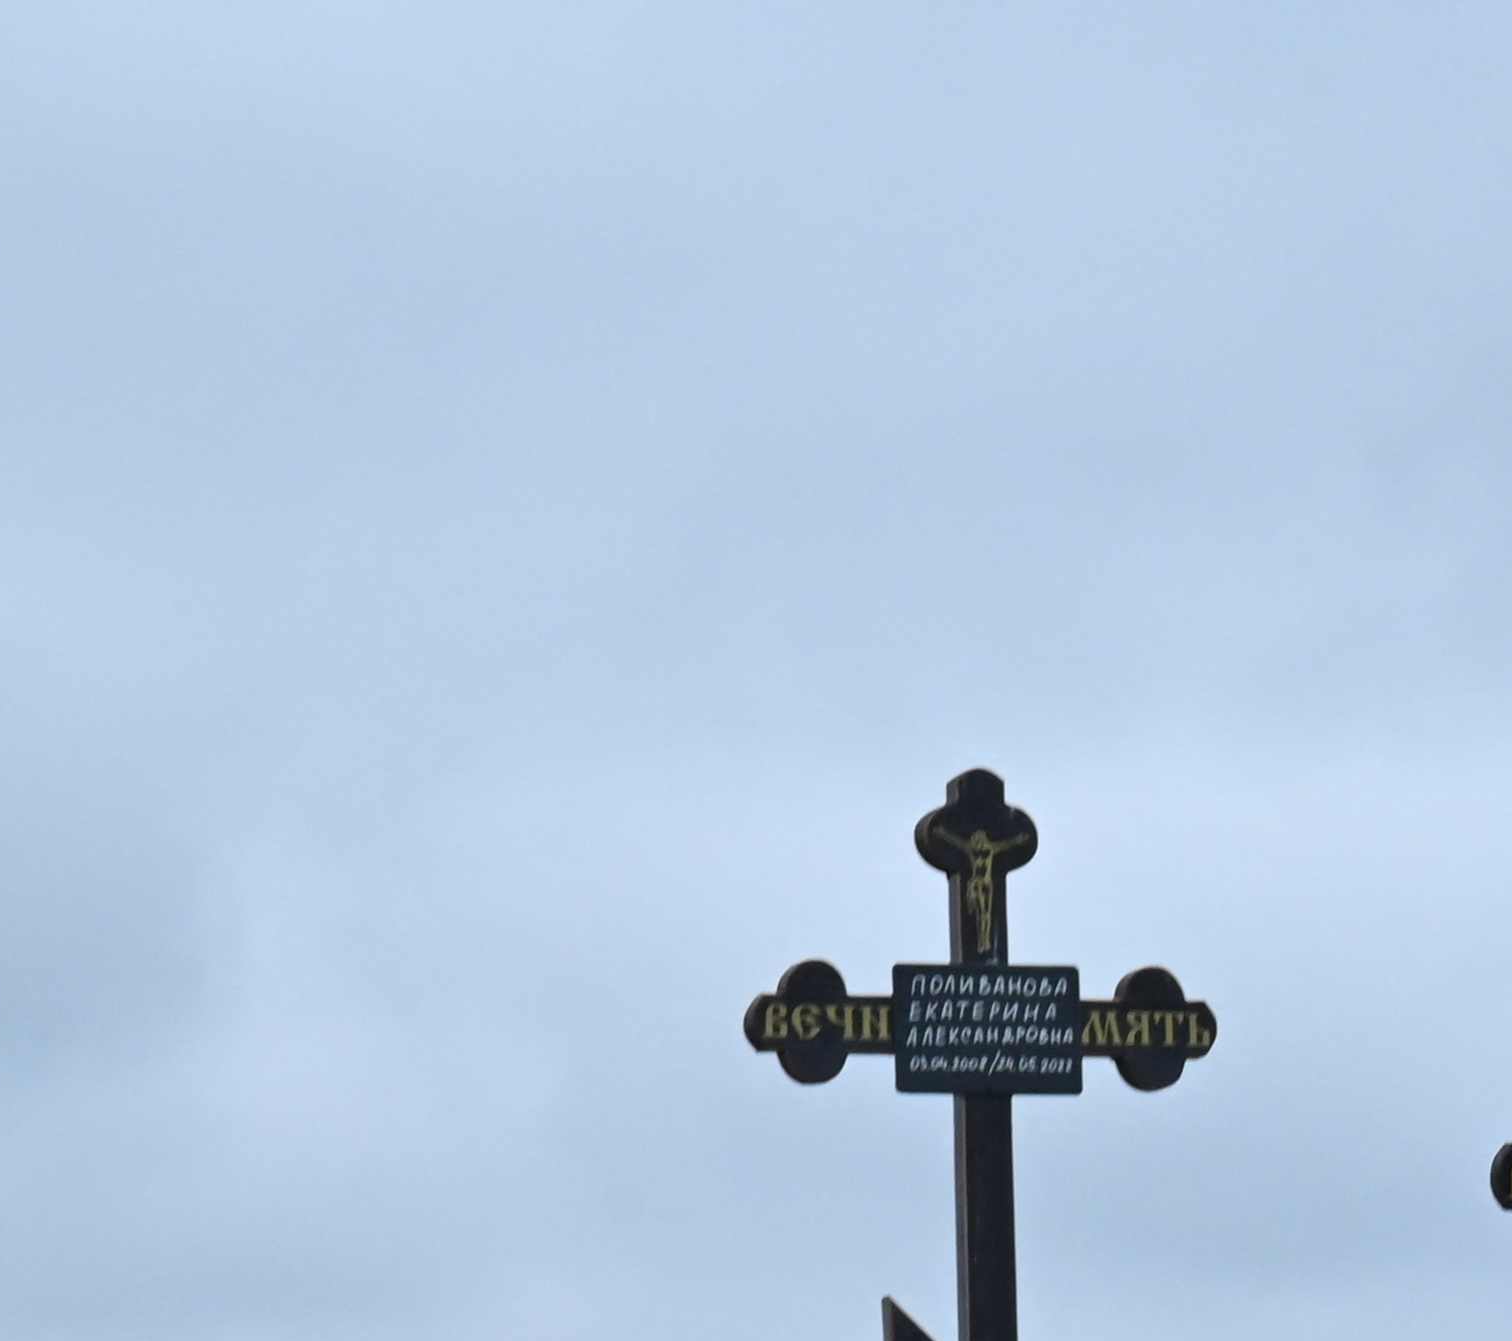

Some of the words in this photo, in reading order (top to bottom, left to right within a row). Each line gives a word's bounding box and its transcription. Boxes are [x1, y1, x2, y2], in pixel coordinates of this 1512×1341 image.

[911, 974, 1069, 998] ПОЛИВАНОВА
[909, 999, 1058, 1022] ЕКАТЕРИНА
[906, 1024, 1074, 1048] АЛЕКСАНДРОВНА
